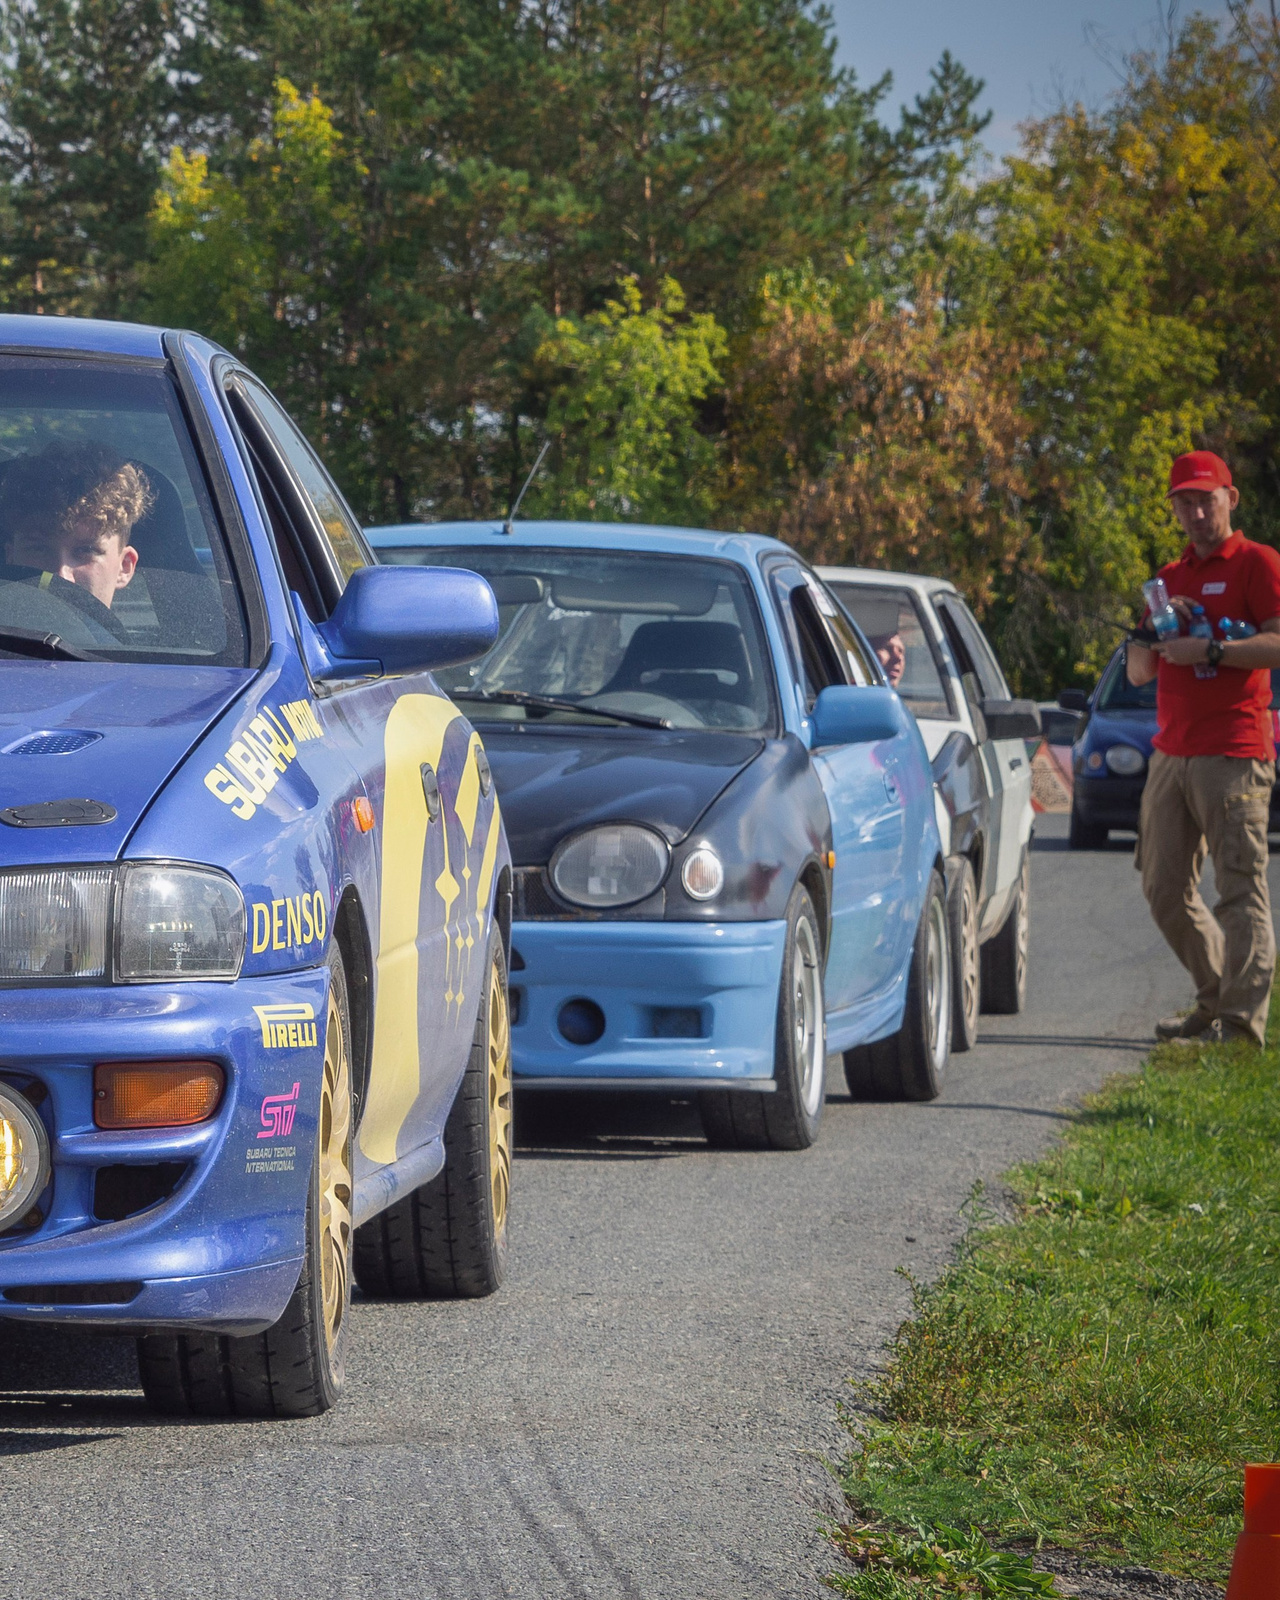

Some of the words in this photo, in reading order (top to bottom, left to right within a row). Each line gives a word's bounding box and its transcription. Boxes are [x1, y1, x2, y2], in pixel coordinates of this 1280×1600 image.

[203, 705, 298, 821] SUBARU
[279, 698, 325, 742] MOTUL
[252, 890, 327, 954] DENSO
[252, 1002, 318, 1048] PIRELLI
[246, 1147, 273, 1160] SUBARU
